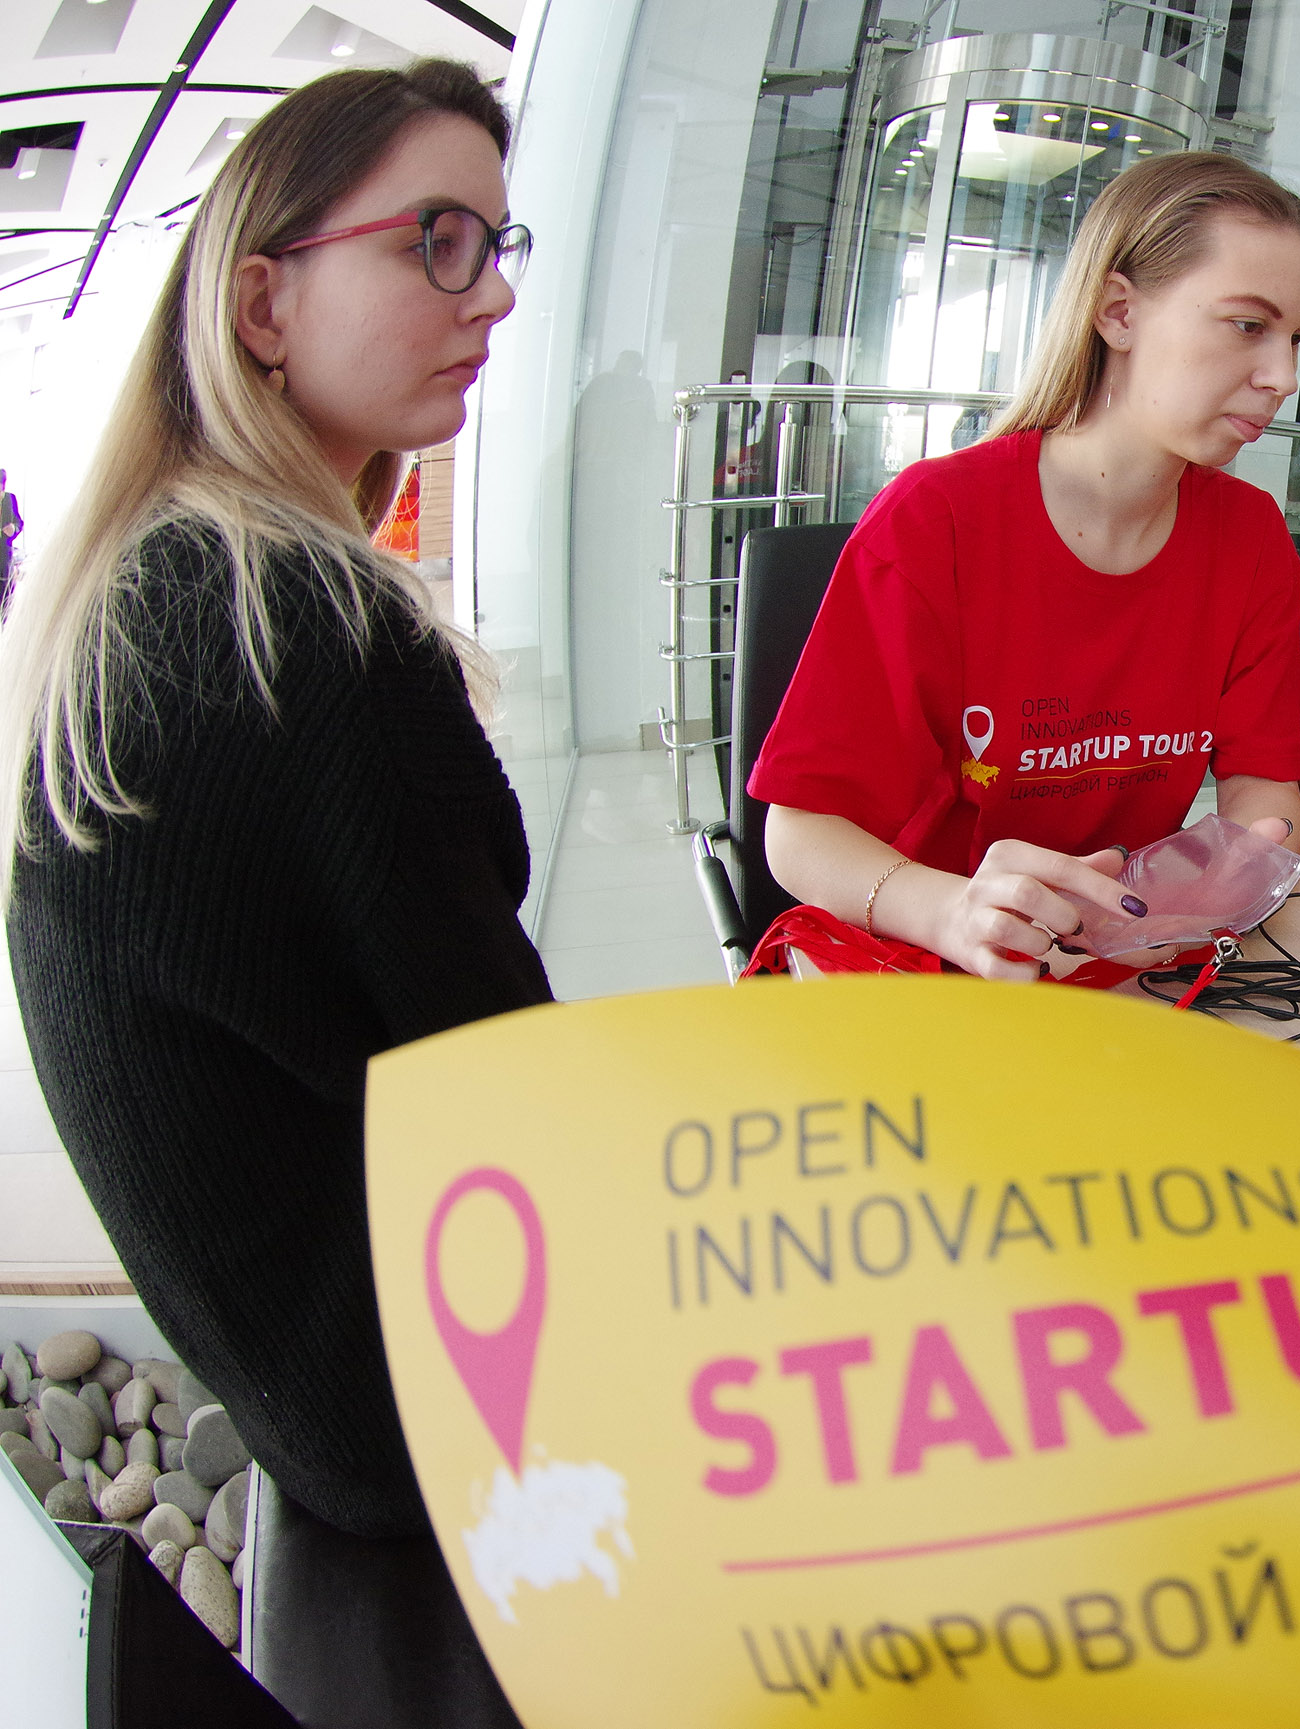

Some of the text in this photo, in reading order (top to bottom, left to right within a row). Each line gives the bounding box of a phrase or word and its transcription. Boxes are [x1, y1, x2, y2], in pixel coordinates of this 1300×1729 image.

[1021, 696, 1070, 717] OPEN
[1021, 708, 1132, 741] INNOVATIONS
[1017, 735, 1131, 772] STARTUP
[1138, 731, 1195, 758] TOUR
[1010, 769, 1169, 801] ЦИФРОВОЙ РЕГИОН
[662, 1094, 926, 1199] OPEN
[740, 1540, 1297, 1708] ЦИФРОВОЙ
